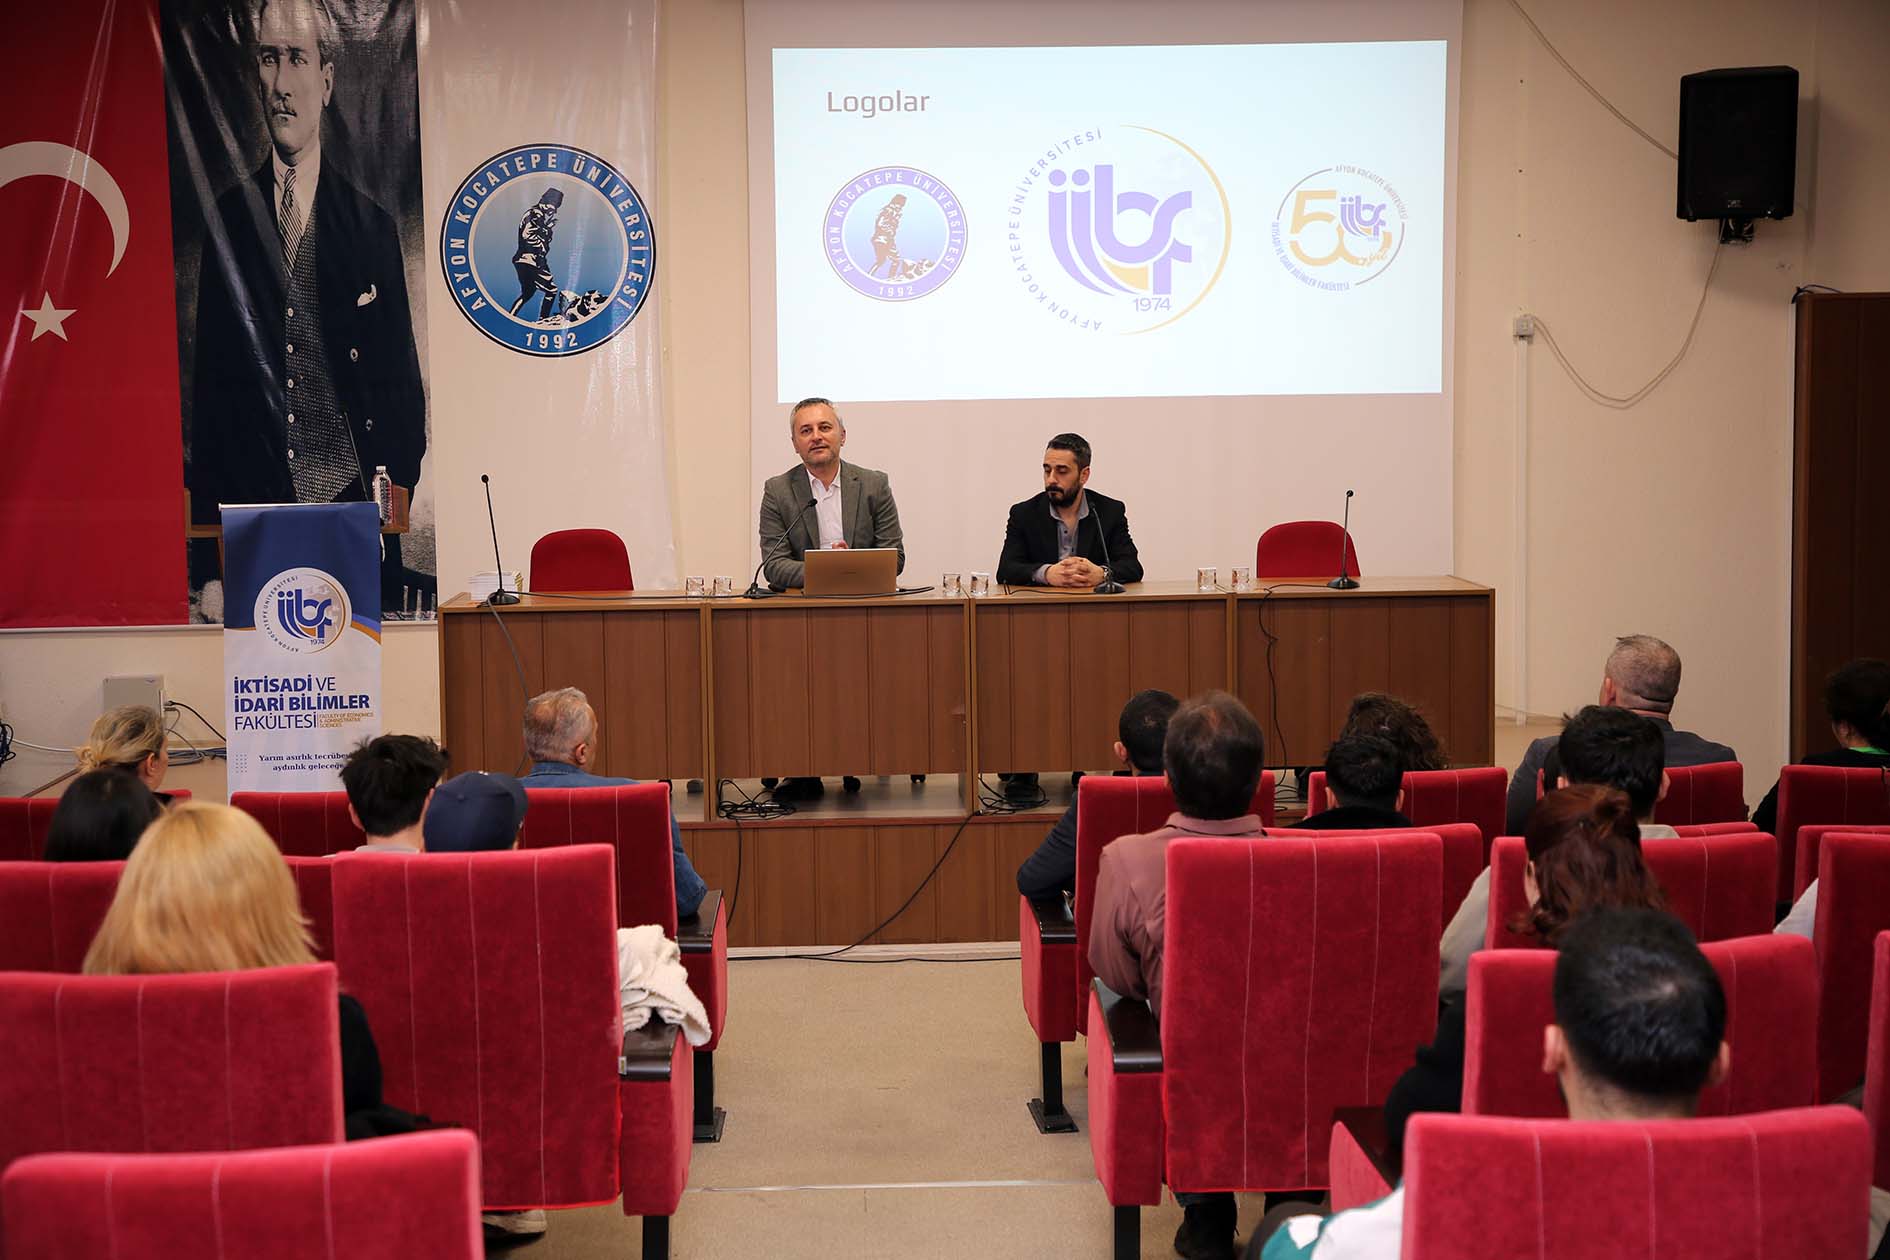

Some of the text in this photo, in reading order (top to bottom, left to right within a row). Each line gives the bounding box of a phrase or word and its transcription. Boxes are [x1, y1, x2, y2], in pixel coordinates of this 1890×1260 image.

[827, 89, 930, 119] Logolar
[833, 172, 903, 218] KOCATEPE
[450, 153, 649, 311] AFYON KOCATEPE ÜNİVERSİTESİ
[829, 227, 853, 274] AFYON
[1008, 221, 1047, 303] KOCATEPE
[879, 286, 914, 297] 1992
[1133, 297, 1172, 312] 1974
[1048, 301, 1102, 331] AFYON
[526, 332, 578, 349] 1992
[234, 674, 336, 694] İKTİSADİ VE
[234, 693, 370, 713] İDARİ BİLİMLER
[234, 711, 317, 731] FAKÜLTESİ
[286, 753, 313, 761] asırlık
[272, 763, 306, 772] aydınlık
